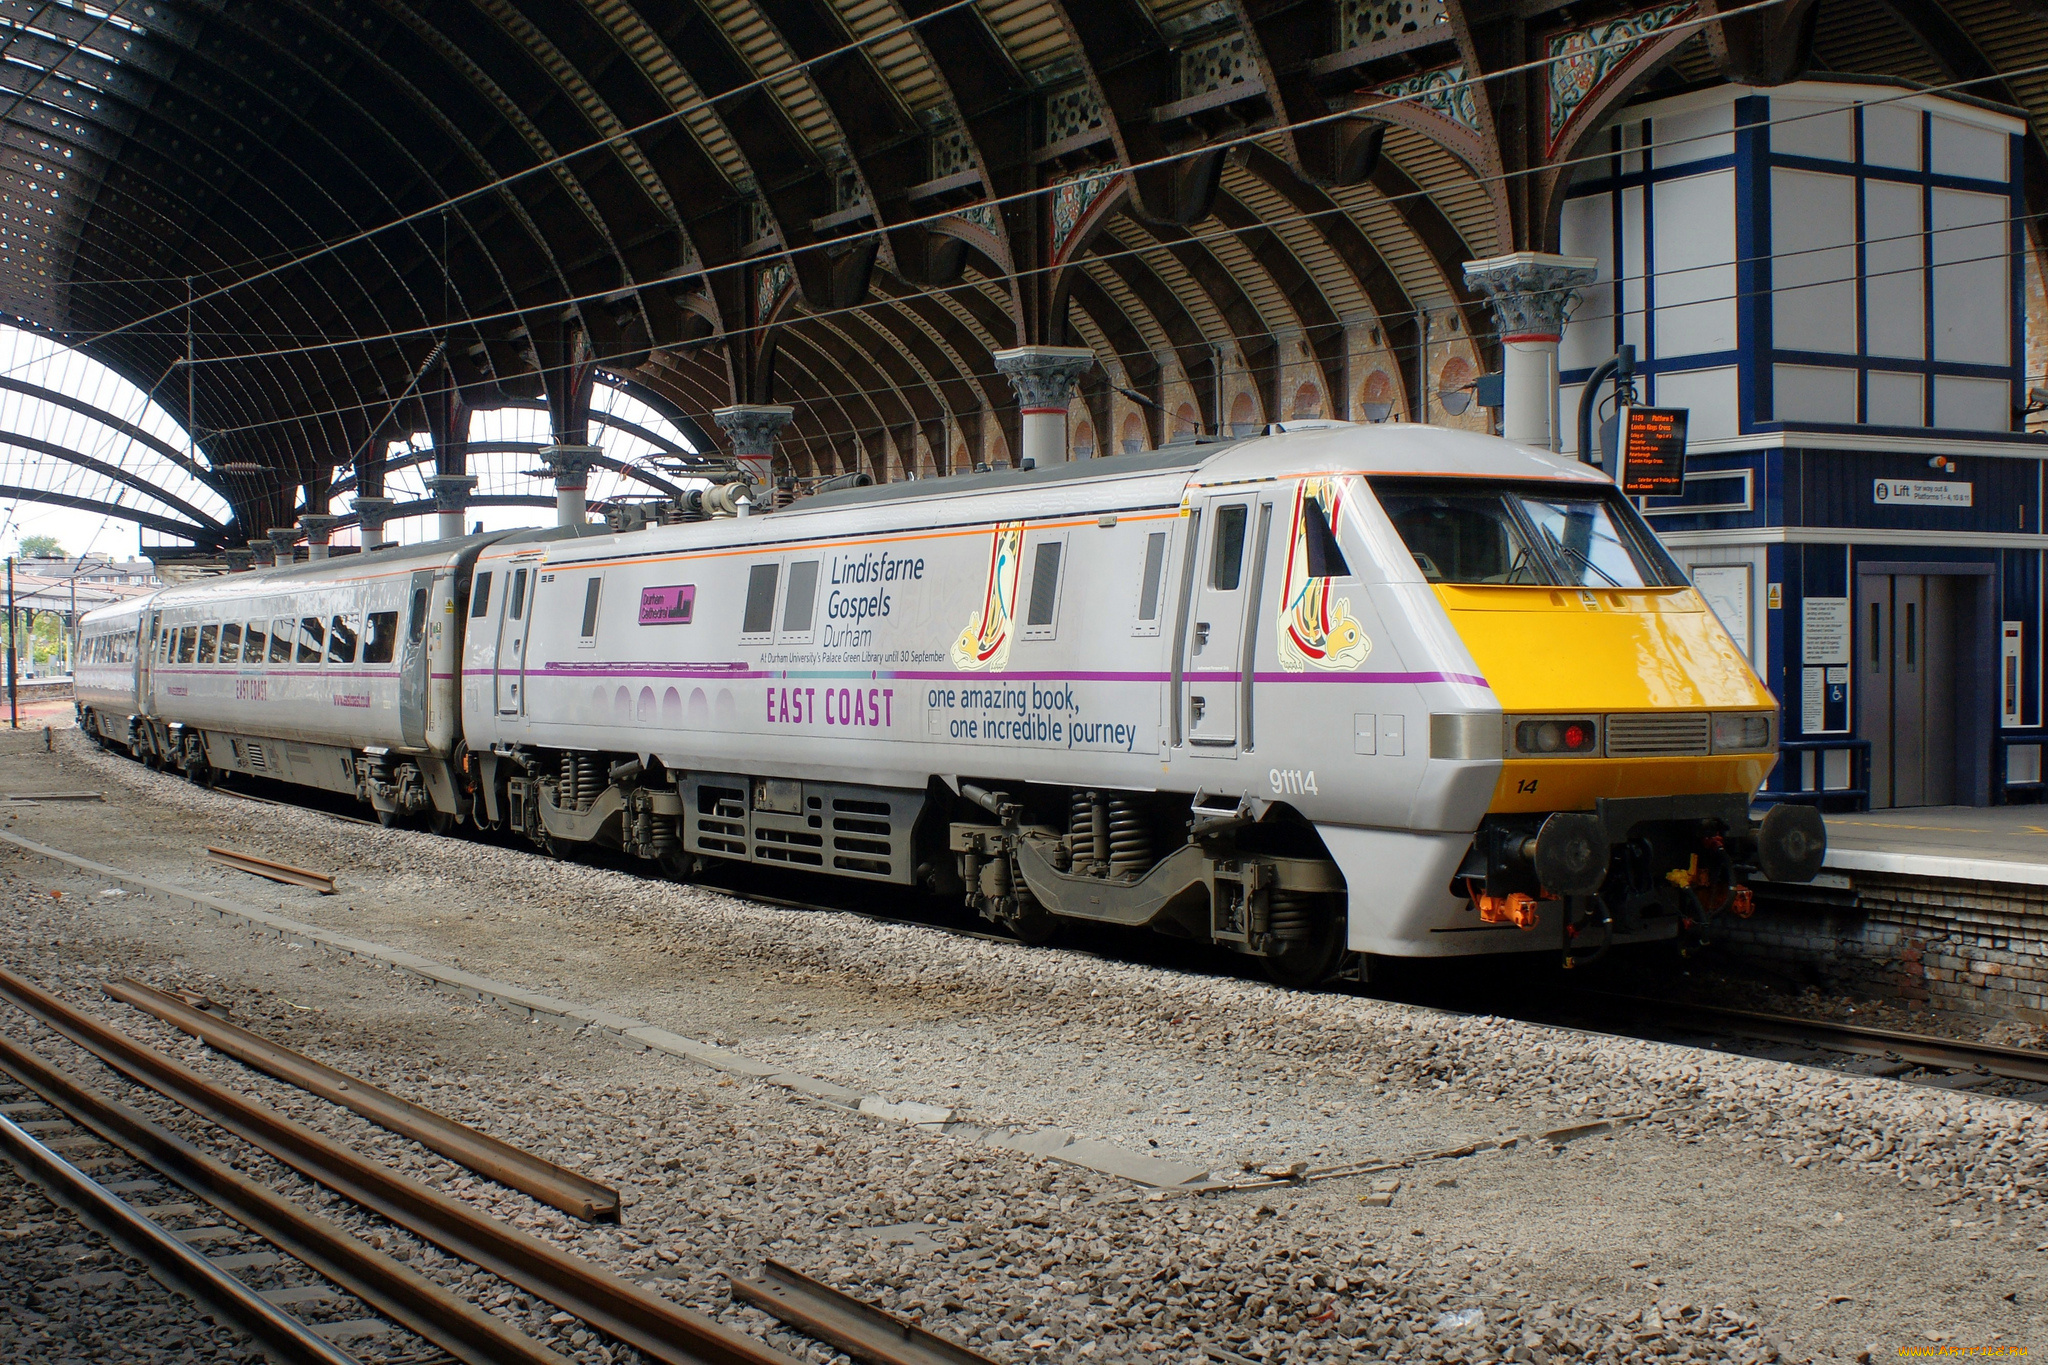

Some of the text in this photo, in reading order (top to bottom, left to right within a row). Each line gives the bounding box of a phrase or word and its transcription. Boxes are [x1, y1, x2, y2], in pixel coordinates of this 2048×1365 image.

[1893, 484, 1910, 497] Lift
[831, 551, 925, 585] Lindisfarne
[643, 593, 665, 606] Durham
[828, 587, 891, 625] Gospels
[823, 623, 872, 648] Durham
[760, 650, 946, 665] At Durham University's Palace Green Library until 30 September
[236, 679, 267, 701] EAST COAST
[928, 681, 1080, 717] one amazing book,
[767, 687, 894, 727] EAST COAST
[950, 712, 1136, 752] one incredible journey
[1269, 768, 1319, 796] 91114
[1517, 779, 1538, 794] 14
